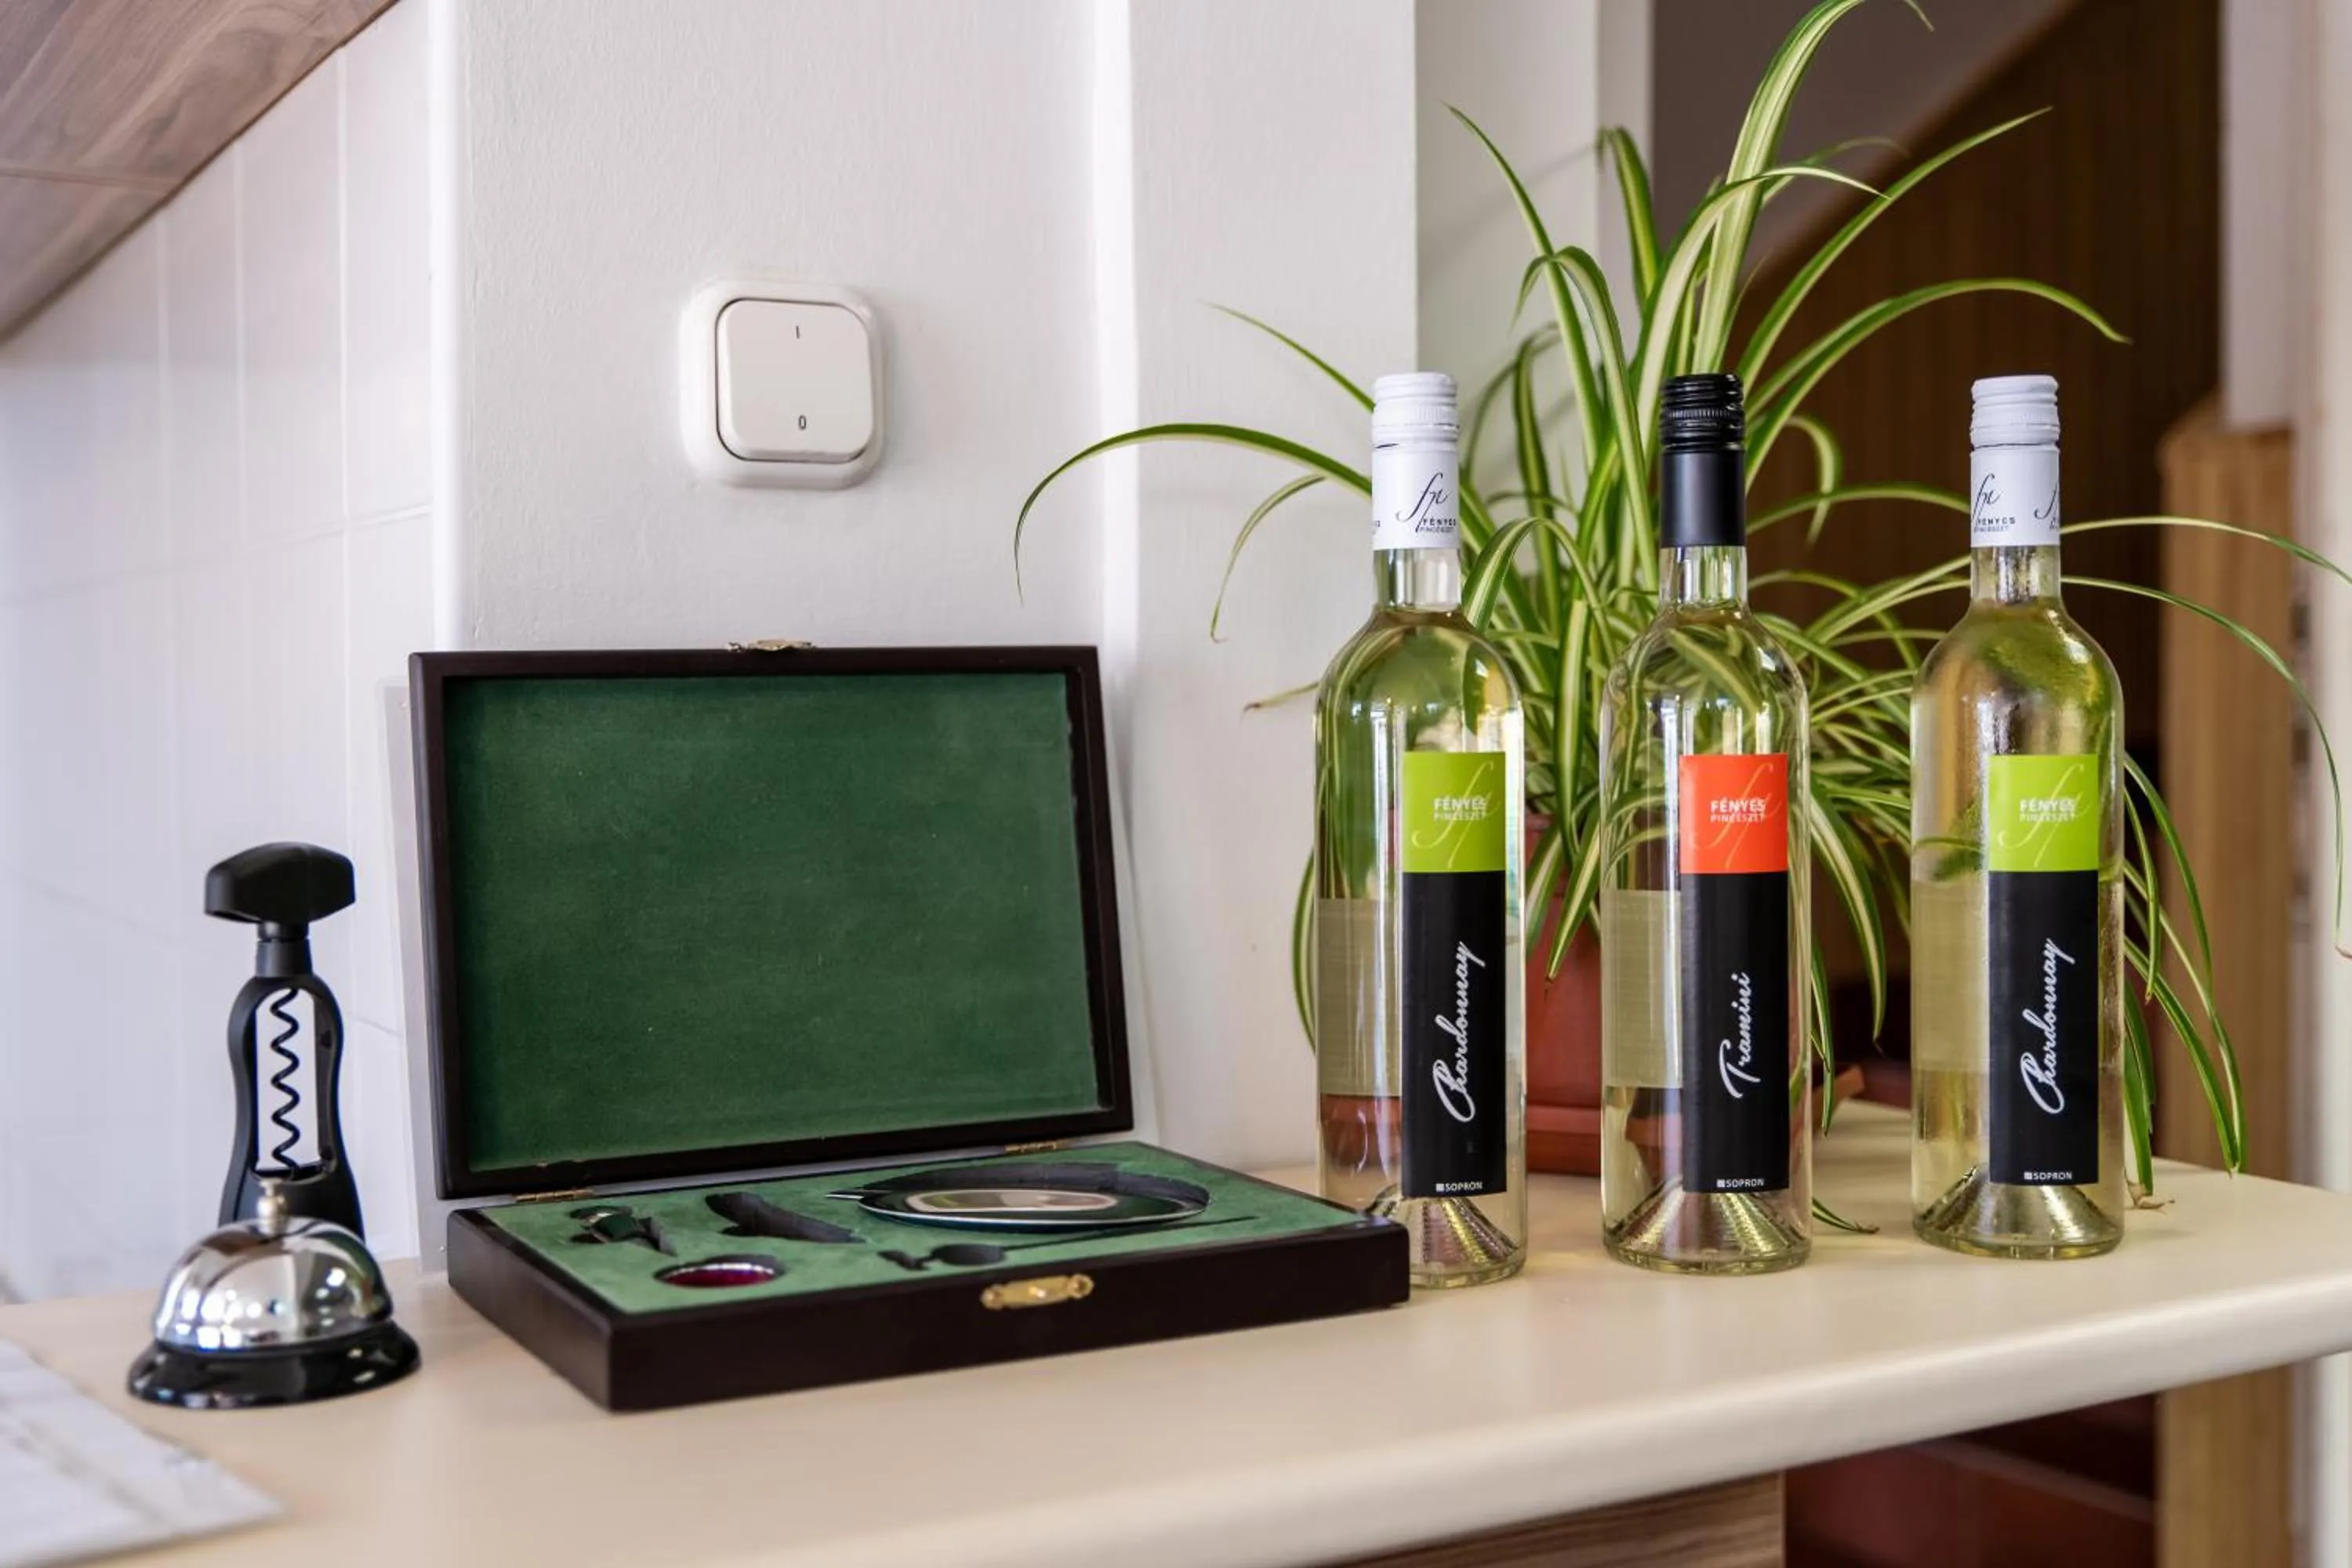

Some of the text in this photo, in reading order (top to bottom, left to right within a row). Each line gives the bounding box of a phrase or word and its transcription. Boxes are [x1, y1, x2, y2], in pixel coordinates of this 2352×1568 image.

[1434, 794, 1486, 811] FÉNYES
[1710, 797, 1766, 813] FÉNYES
[1432, 941, 1486, 1123] Chardonnay
[2020, 938, 2076, 1114] Chardonnay
[1719, 972, 1761, 1098] Tramini
[1726, 1178, 1764, 1188] SOPRON
[2032, 1171, 2072, 1180] SOPRON
[1445, 1181, 1483, 1192] SOPRON
